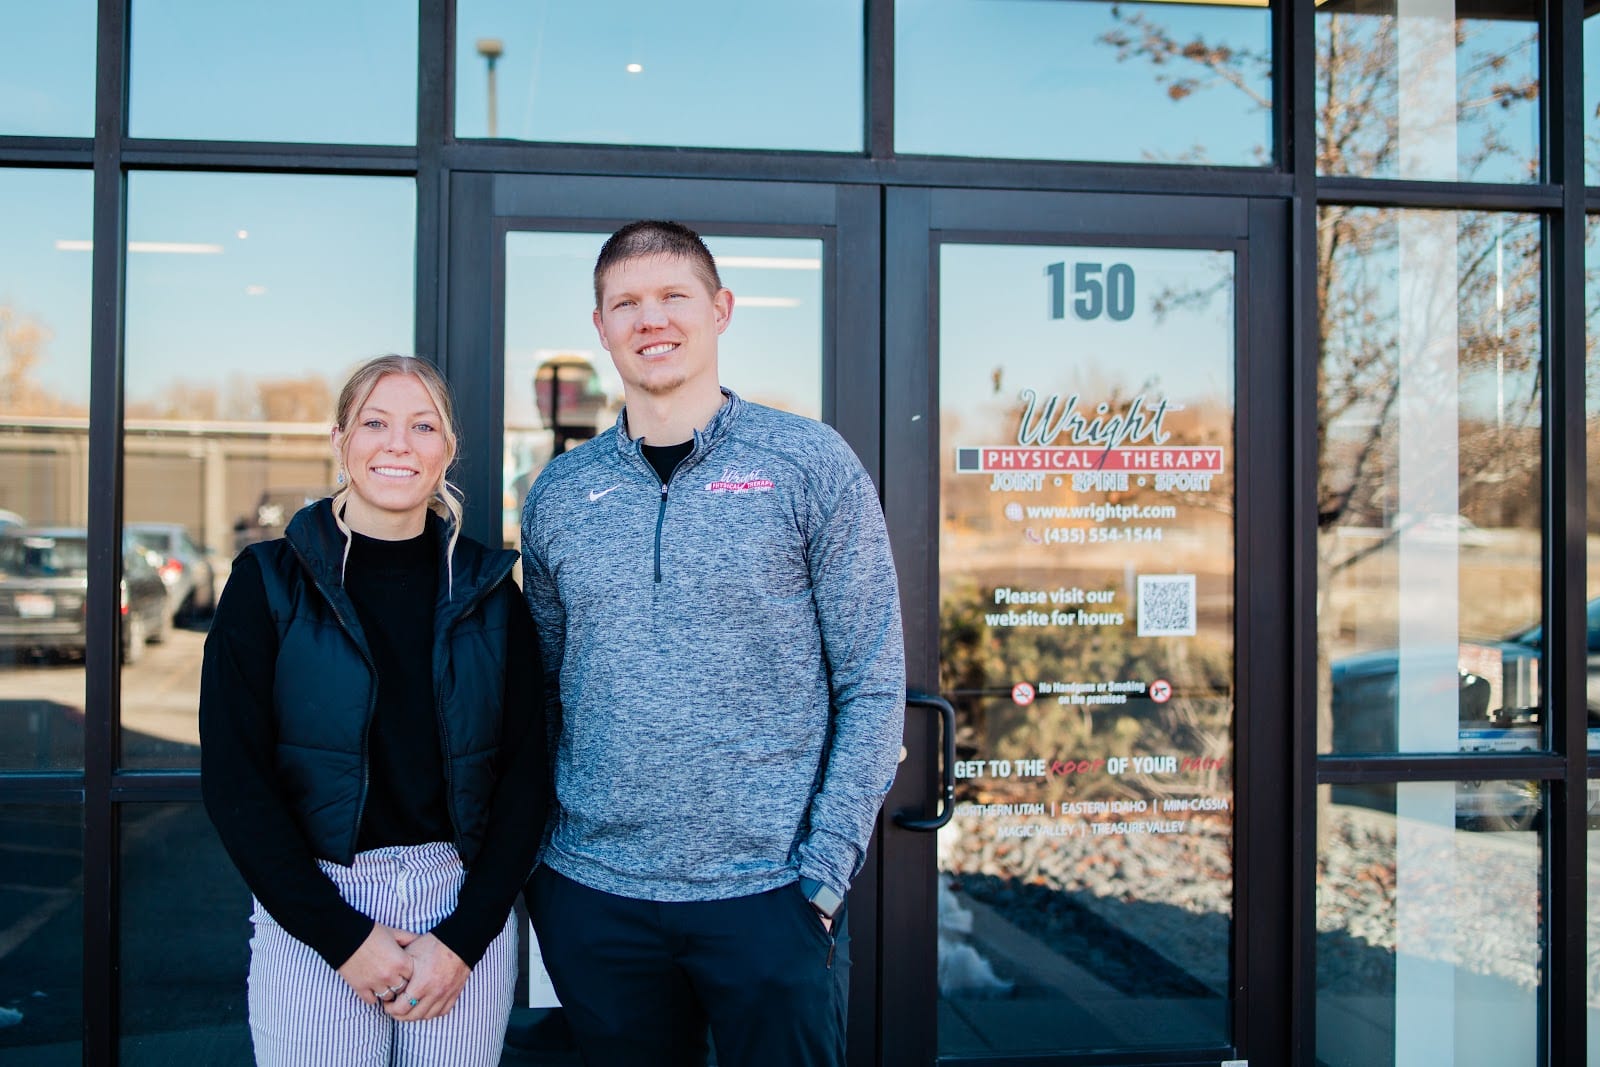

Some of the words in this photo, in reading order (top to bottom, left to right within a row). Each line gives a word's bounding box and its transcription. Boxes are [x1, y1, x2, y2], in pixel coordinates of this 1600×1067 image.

[1046, 261, 1136, 322] 150
[1018, 388, 1183, 471] Wright
[987, 451, 1093, 469] PHYSICAL
[1121, 450, 1218, 469] THERAPY
[990, 473, 1045, 492] JOINT
[1071, 473, 1129, 492] SPINE
[1155, 473, 1213, 492] SPORT
[1027, 503, 1177, 522] www.wrightpt.com
[1044, 528, 1085, 546] (435)
[1089, 527, 1163, 544] 554-1544
[994, 588, 1047, 605] Please
[1050, 587, 1084, 604] visit
[1086, 590, 1115, 603] our
[985, 610, 1048, 627] website
[1051, 610, 1076, 626] for
[1078, 610, 1125, 626] hours
[1039, 682, 1051, 693] No
[1053, 682, 1096, 694] Handguns
[1097, 683, 1107, 692] or
[1108, 681, 1145, 693] Smoking
[1058, 695, 1070, 704] on
[1071, 695, 1085, 704] the
[1086, 694, 1127, 706] premises
[954, 760, 986, 778] GET
[989, 759, 1011, 778] TO
[1014, 759, 1046, 777] THE
[1050, 759, 1106, 776] ROOT
[1107, 757, 1129, 775] OF
[1132, 756, 1177, 774] YOUR
[1014, 803, 1045, 815] UTAH
[1062, 802, 1109, 814] EASTERN
[1111, 801, 1147, 813] IDAHO
[1164, 799, 1228, 811] MINI-CASSIA
[998, 825, 1032, 838] MAGIC
[1091, 822, 1145, 835] TREASURE
[1146, 821, 1185, 833] VALLEY
